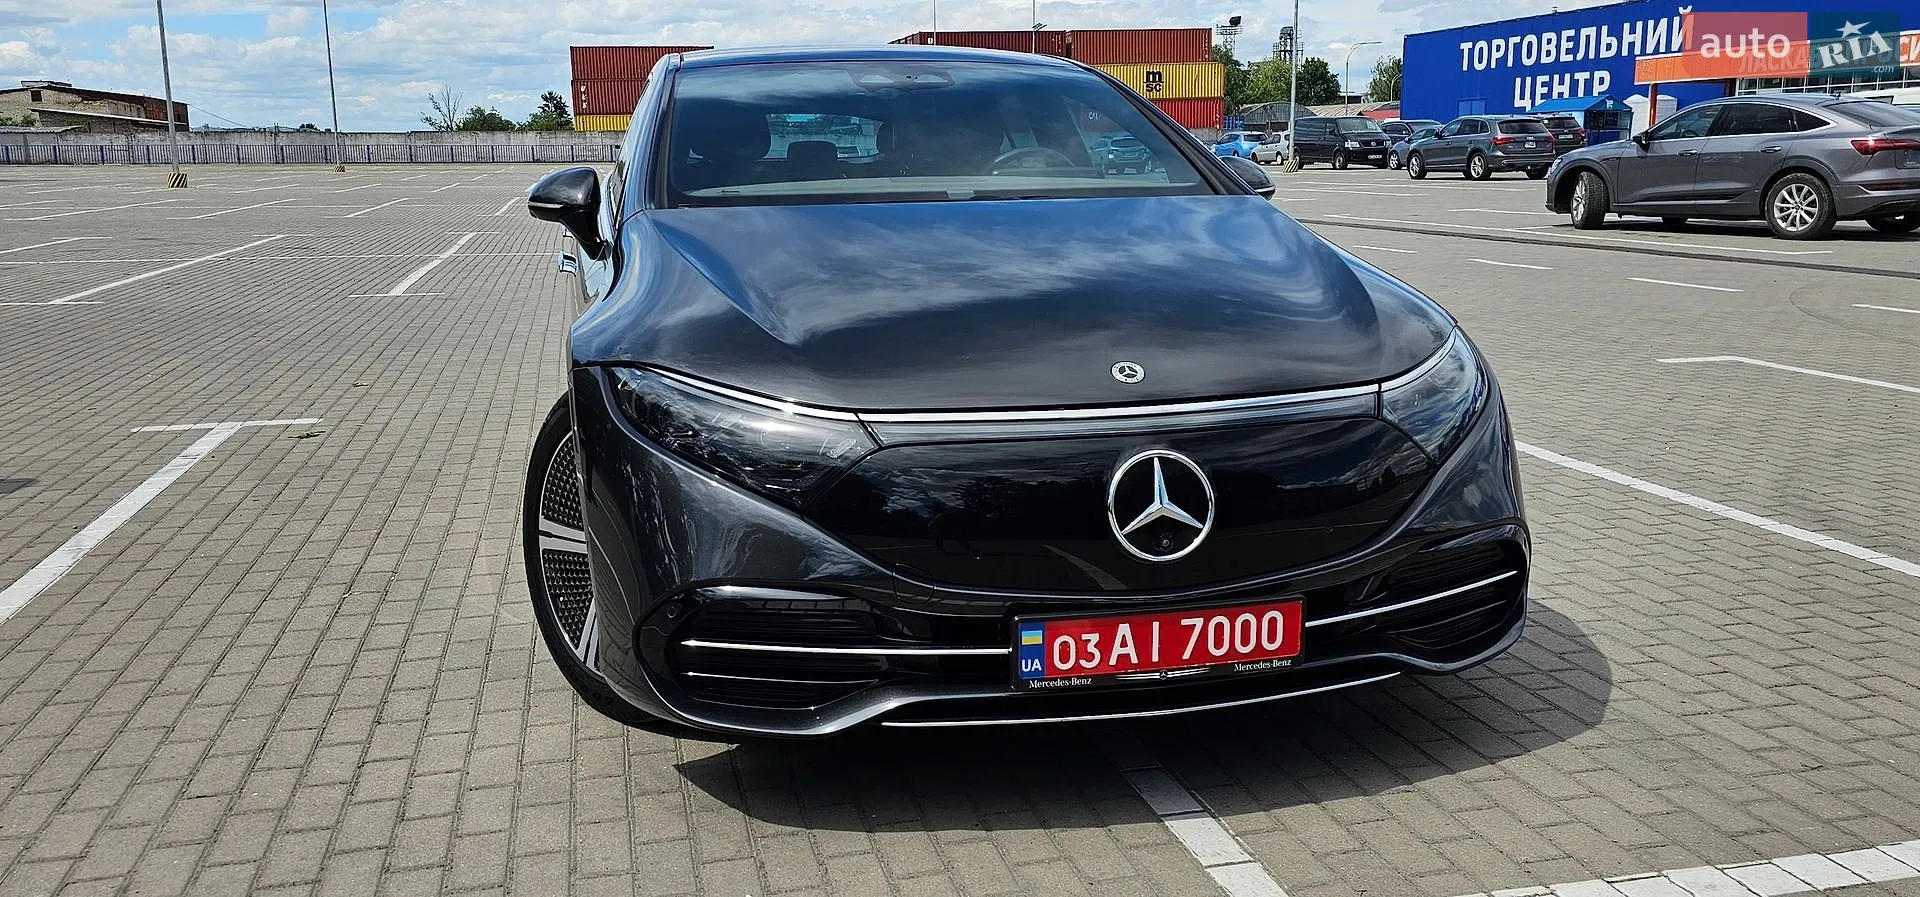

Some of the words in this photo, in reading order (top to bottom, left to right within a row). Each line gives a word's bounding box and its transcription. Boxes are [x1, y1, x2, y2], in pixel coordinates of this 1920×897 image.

[1460, 5, 1695, 71] ТОРГОВЕЛЬНИЙ
[1514, 70, 1611, 112] ЦЕНТР
[1180, 610, 1284, 660] 7000
[1021, 658, 1042, 672] UA
[1233, 658, 1292, 672] Mercedes-Benz
[1029, 677, 1092, 689] Mercedes-Benz
